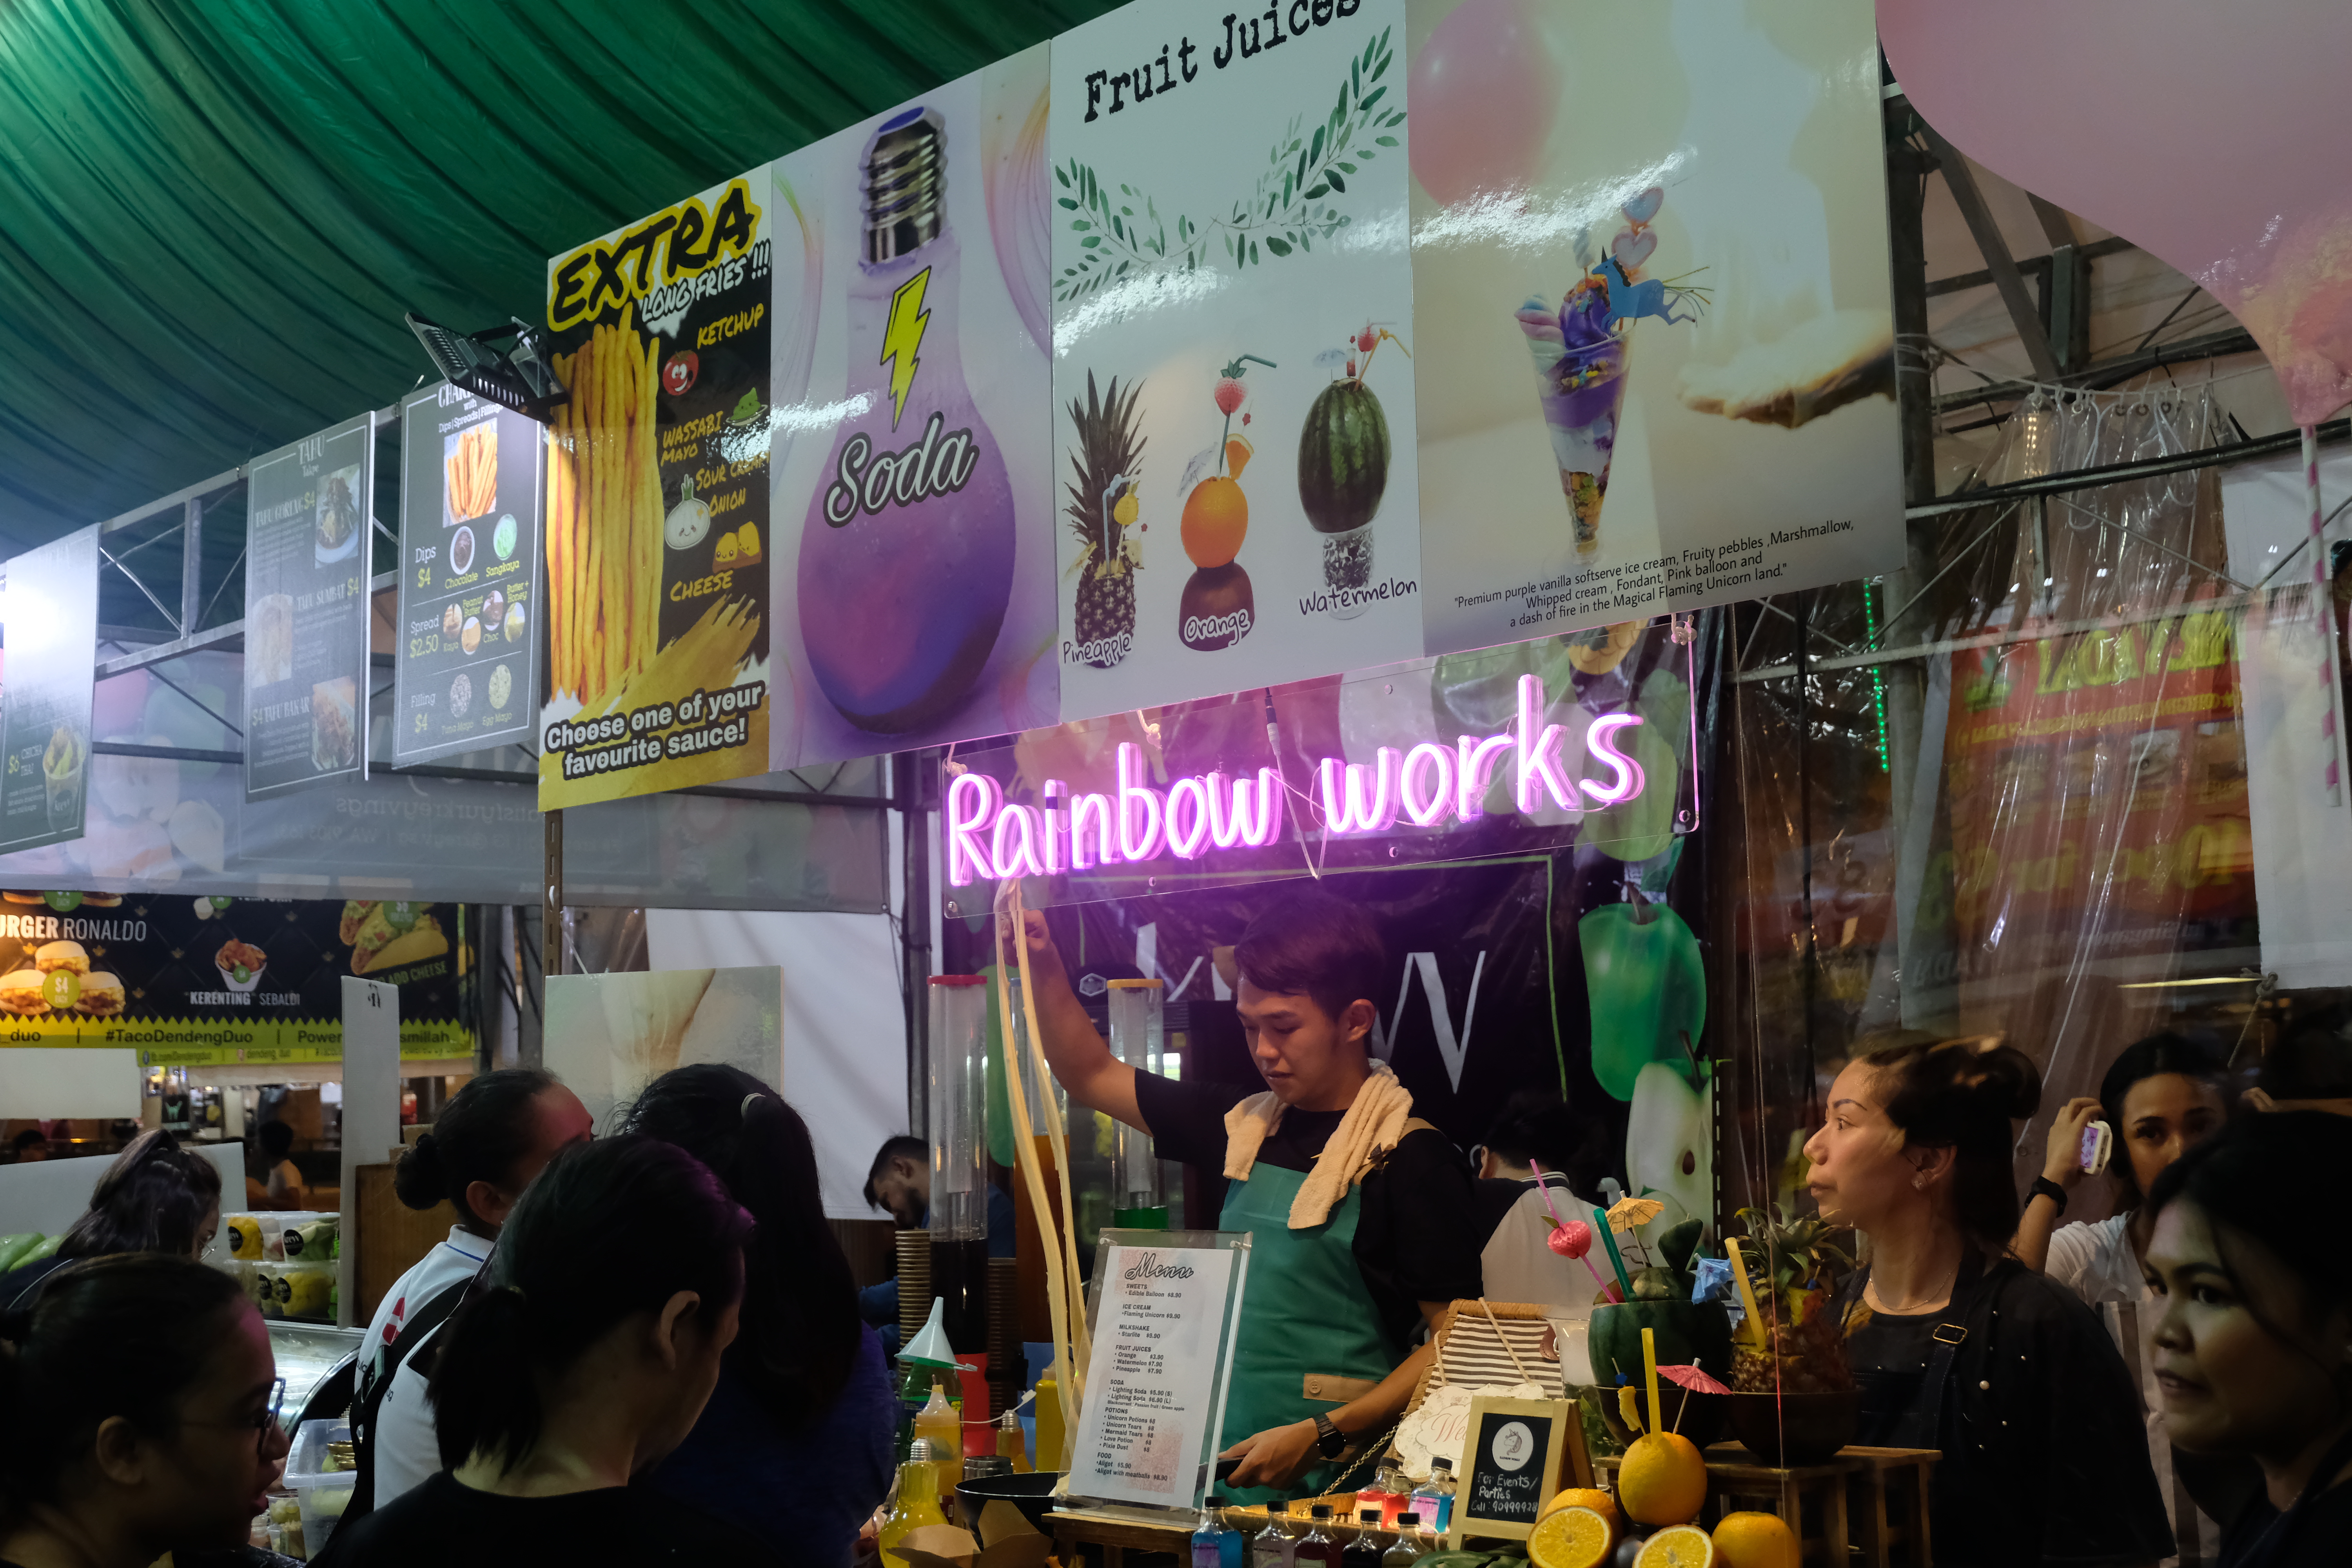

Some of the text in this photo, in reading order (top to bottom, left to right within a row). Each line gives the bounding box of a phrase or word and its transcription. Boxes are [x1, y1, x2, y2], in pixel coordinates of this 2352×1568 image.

[1085, 37, 1198, 123] Fruit
[552, 187, 755, 323] EXTRA
[642, 279, 692, 322] LONG
[696, 256, 747, 301] FRIES
[697, 303, 764, 349] KETCHUP
[463, 398, 477, 411] with
[663, 411, 723, 448] WASSABI
[661, 443, 697, 466] MAYO
[696, 464, 726, 490] SOUR
[826, 417, 976, 523] Soda
[304, 490, 315, 510] $4
[709, 487, 746, 517] ONION
[416, 547, 436, 564] Dips
[417, 568, 431, 588] $4
[445, 559, 520, 589] Chocolate Sangkaya
[1455, 592, 1501, 608] "Premium
[1505, 583, 1536, 601] purple
[1540, 575, 1571, 592] vanilla
[1575, 567, 1622, 584] softserve
[1625, 562, 1639, 574] ice
[1643, 556, 1679, 570] cream,
[1683, 548, 1715, 563] Fruity
[1719, 537, 1763, 559] pebbles
[1526, 551, 1762, 610] Whipped cream Fondant, Pink balloon and
[347, 577, 359, 596] $4
[507, 580, 524, 594] Butter
[507, 590, 527, 603] Honey
[670, 570, 733, 602] CHEESE
[1299, 578, 1417, 615] Watermelon
[1510, 563, 1787, 627] a dash of fire in the Magical Flaming Unicorn land."
[463, 595, 483, 609] Peanut
[410, 615, 439, 636] Spread
[483, 632, 499, 643] Choc
[1185, 612, 1249, 646] Orange
[410, 634, 438, 658] $2.50
[1063, 635, 1132, 667] Pineapple
[411, 692, 436, 708] Filling
[415, 713, 427, 733] $4
[483, 715, 494, 726] Egg
[495, 711, 512, 724] Mayo
[548, 686, 762, 749] Choose one of your
[565, 718, 745, 775] favourite sauce!
[949, 674, 1644, 886] Rainbow works
[64, 918, 147, 941] RONALDO
[54, 976, 69, 994] $4
[106, 1029, 450, 1045] #TacoDendengDuo Power smillah
[1125, 1252, 1194, 1279] Menu
[1478, 1472, 1494, 1484] For
[1479, 1486, 1510, 1499] Parties
